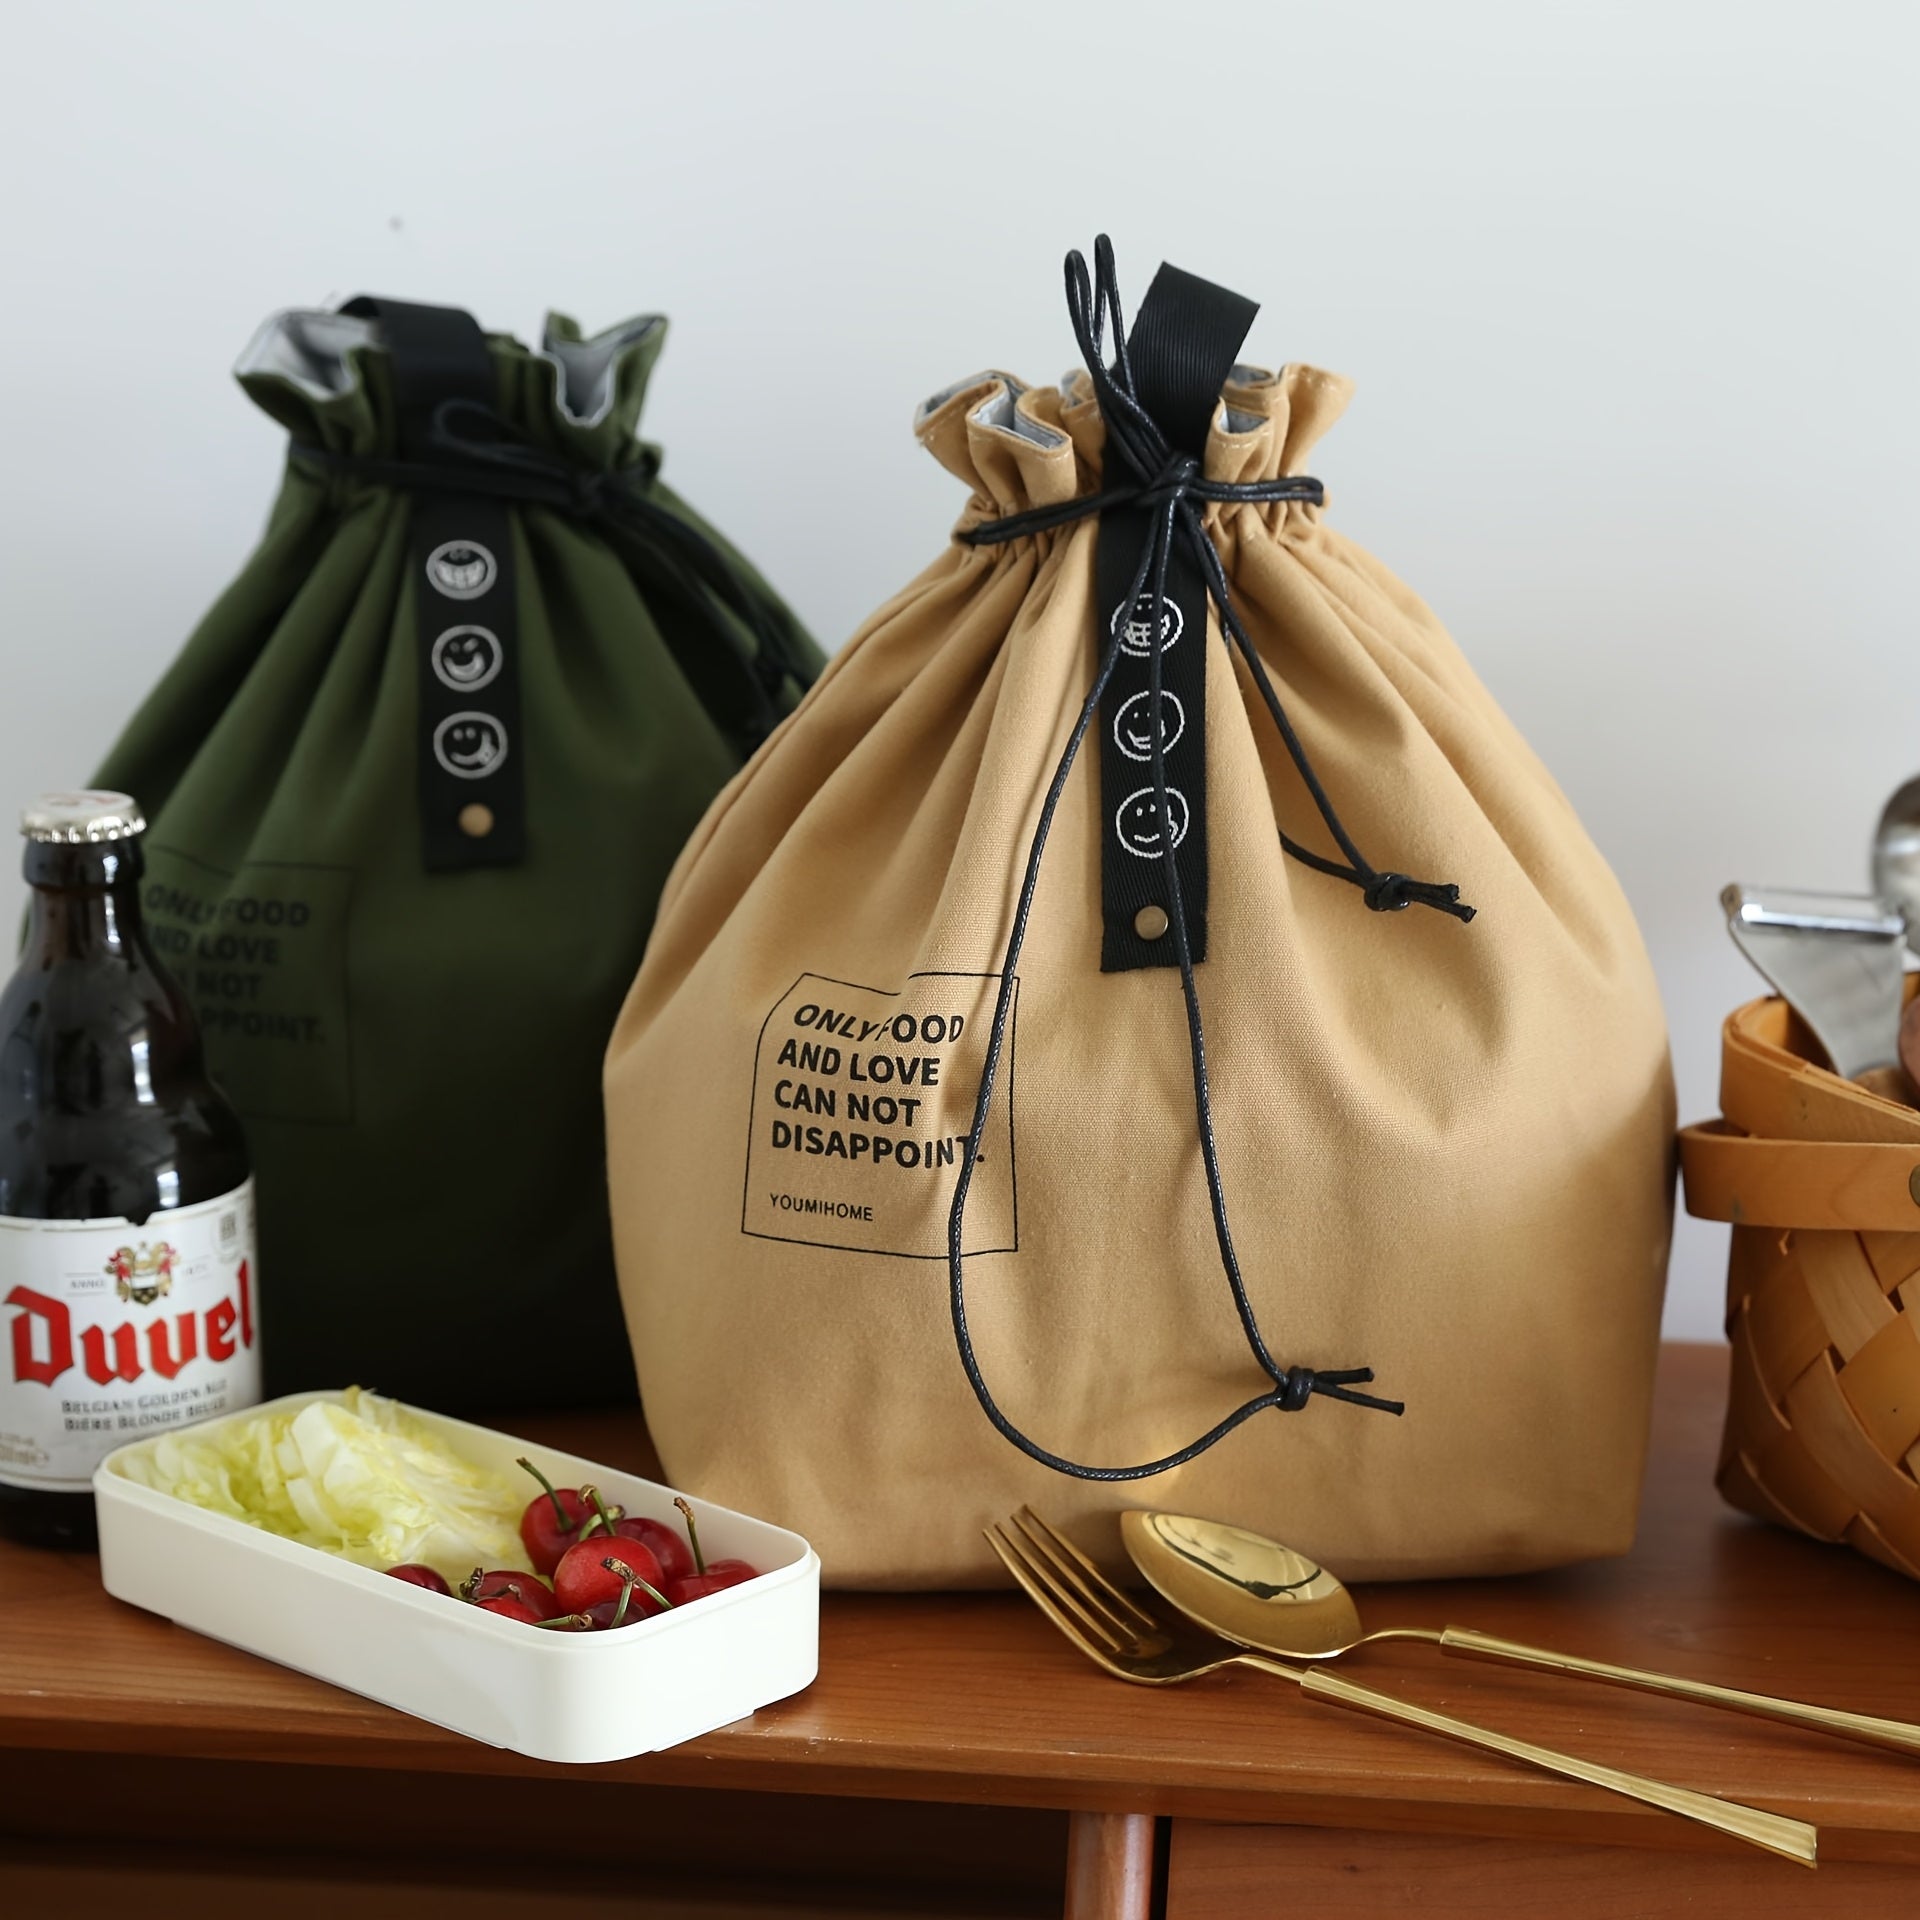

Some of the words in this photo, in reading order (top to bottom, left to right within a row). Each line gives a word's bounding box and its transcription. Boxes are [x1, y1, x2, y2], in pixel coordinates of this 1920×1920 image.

[154, 925, 191, 955] ND
[197, 934, 280, 966] LOVE
[195, 969, 263, 1001] NOT
[793, 1004, 880, 1042] ONLY
[874, 1013, 965, 1044] FOOD
[777, 1038, 841, 1076] AND
[849, 1053, 941, 1086] LOVE
[774, 1079, 836, 1118] CAN
[847, 1092, 922, 1127] NOT
[769, 1192, 874, 1222] YOUMIHOME
[6, 1258, 254, 1388] Duvel
